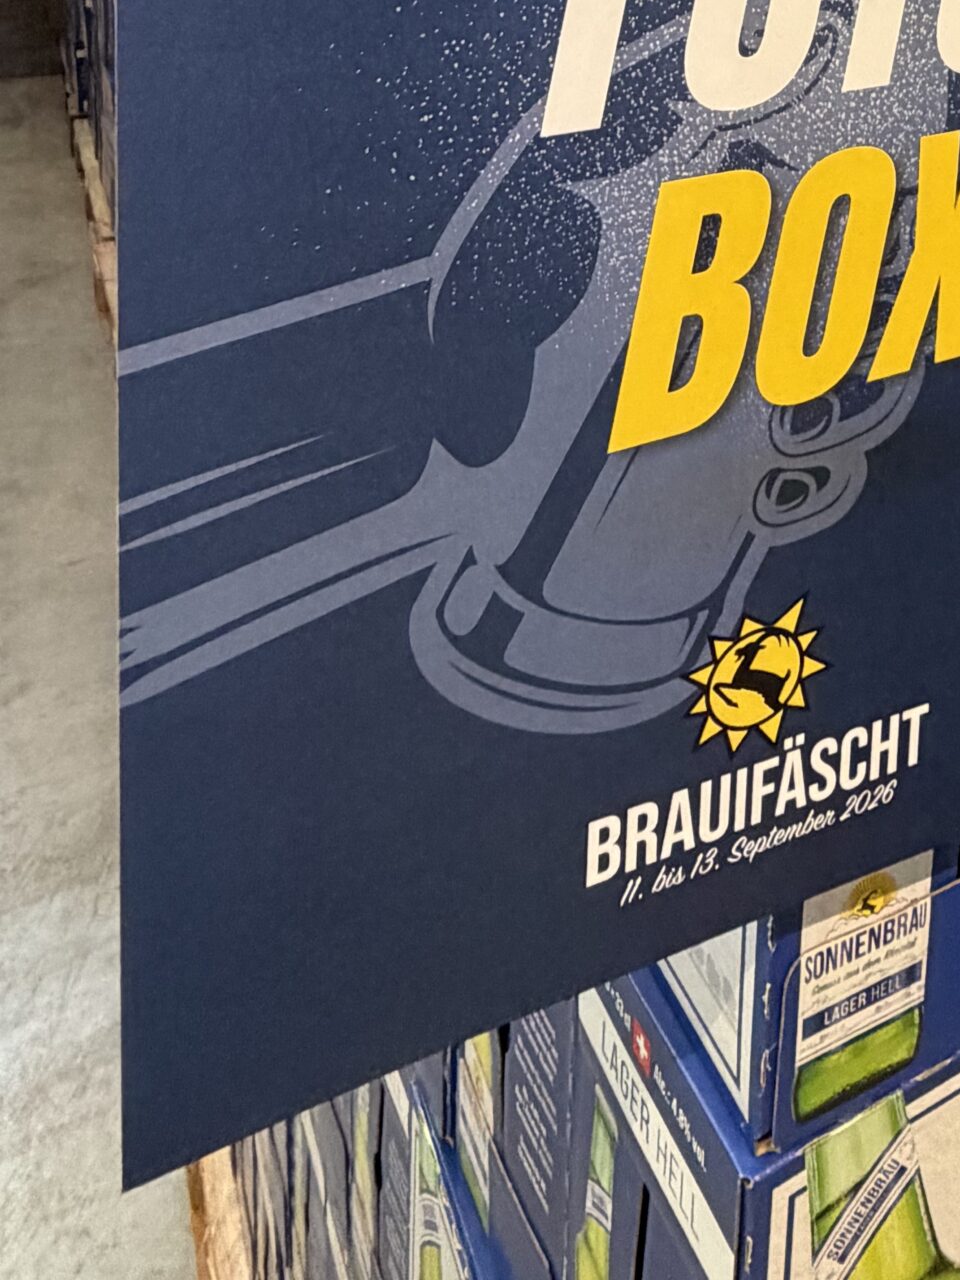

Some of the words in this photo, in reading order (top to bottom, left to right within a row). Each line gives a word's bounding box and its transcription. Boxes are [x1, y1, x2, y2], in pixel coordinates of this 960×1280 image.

[585, 702, 930, 889] BRAUIFÄSCHT
[619, 879, 643, 909] 11.
[652, 864, 686, 893] bis
[690, 851, 721, 879] 13.
[726, 811, 836, 864] September
[839, 779, 898, 822] 2026
[823, 992, 866, 1025] LAGER
[871, 975, 900, 1001] HELL
[601, 1020, 650, 1145] LAGER
[656, 1127, 700, 1243] HELL
[826, 1158, 900, 1262] SONNENBRÄU
